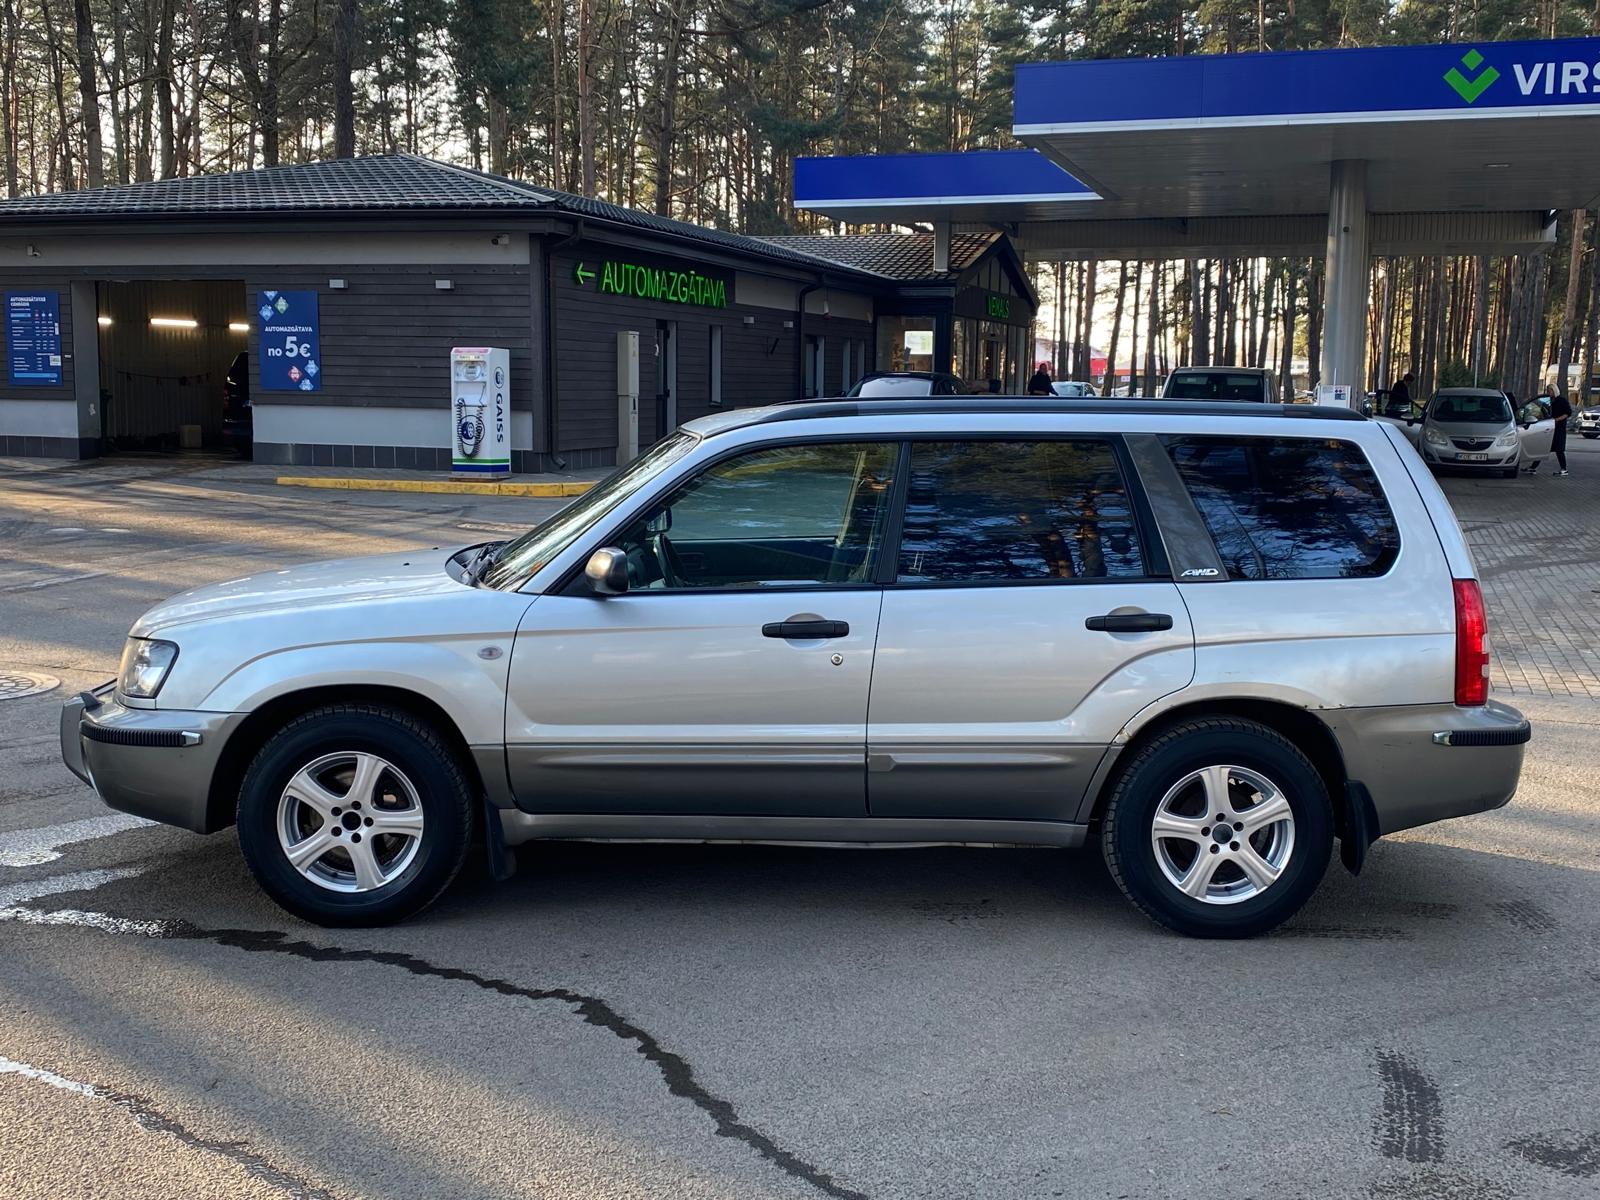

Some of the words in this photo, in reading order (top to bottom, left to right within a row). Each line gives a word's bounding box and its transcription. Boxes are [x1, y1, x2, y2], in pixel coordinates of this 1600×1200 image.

[602, 261, 726, 307] AUTOMAZGĀTAVA
[267, 347, 282, 357] no
[496, 392, 504, 443] GAISS
[1180, 568, 1219, 577] AWD
